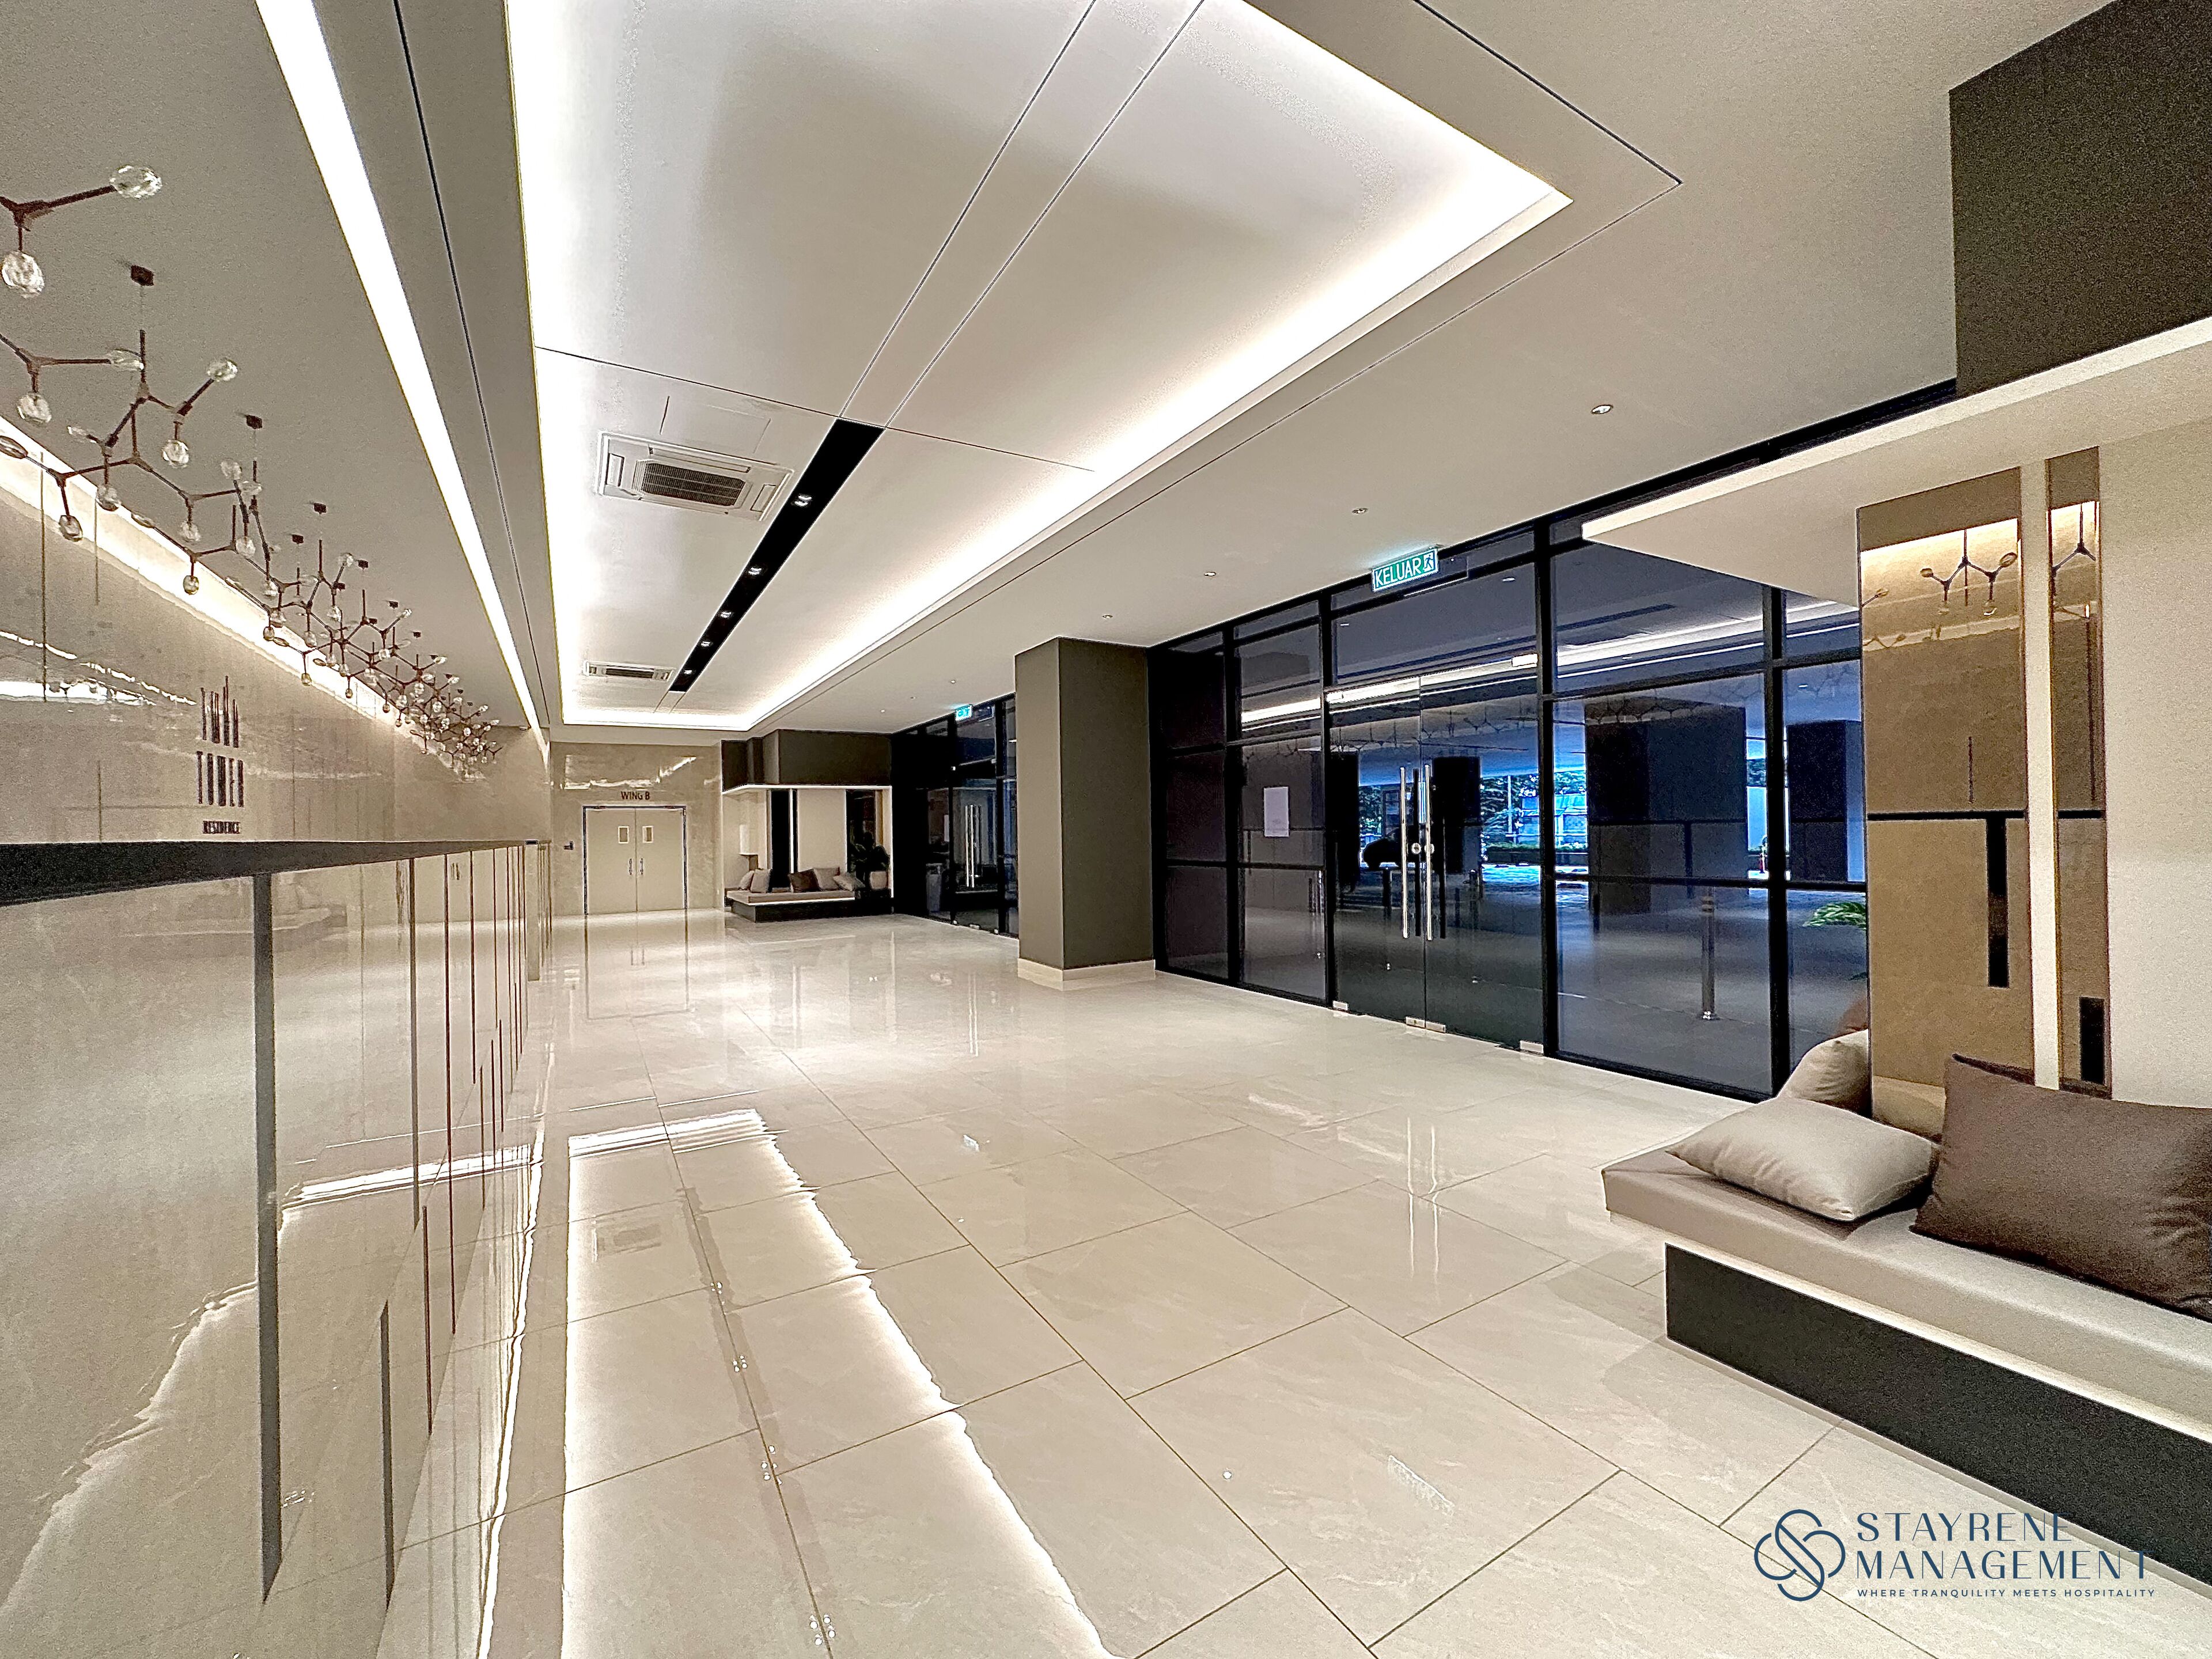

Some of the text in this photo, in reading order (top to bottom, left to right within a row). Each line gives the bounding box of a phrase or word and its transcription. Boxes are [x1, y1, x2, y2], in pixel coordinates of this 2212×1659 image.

[1375, 557, 1422, 588] KELUAR
[620, 790, 650, 800] WING B
